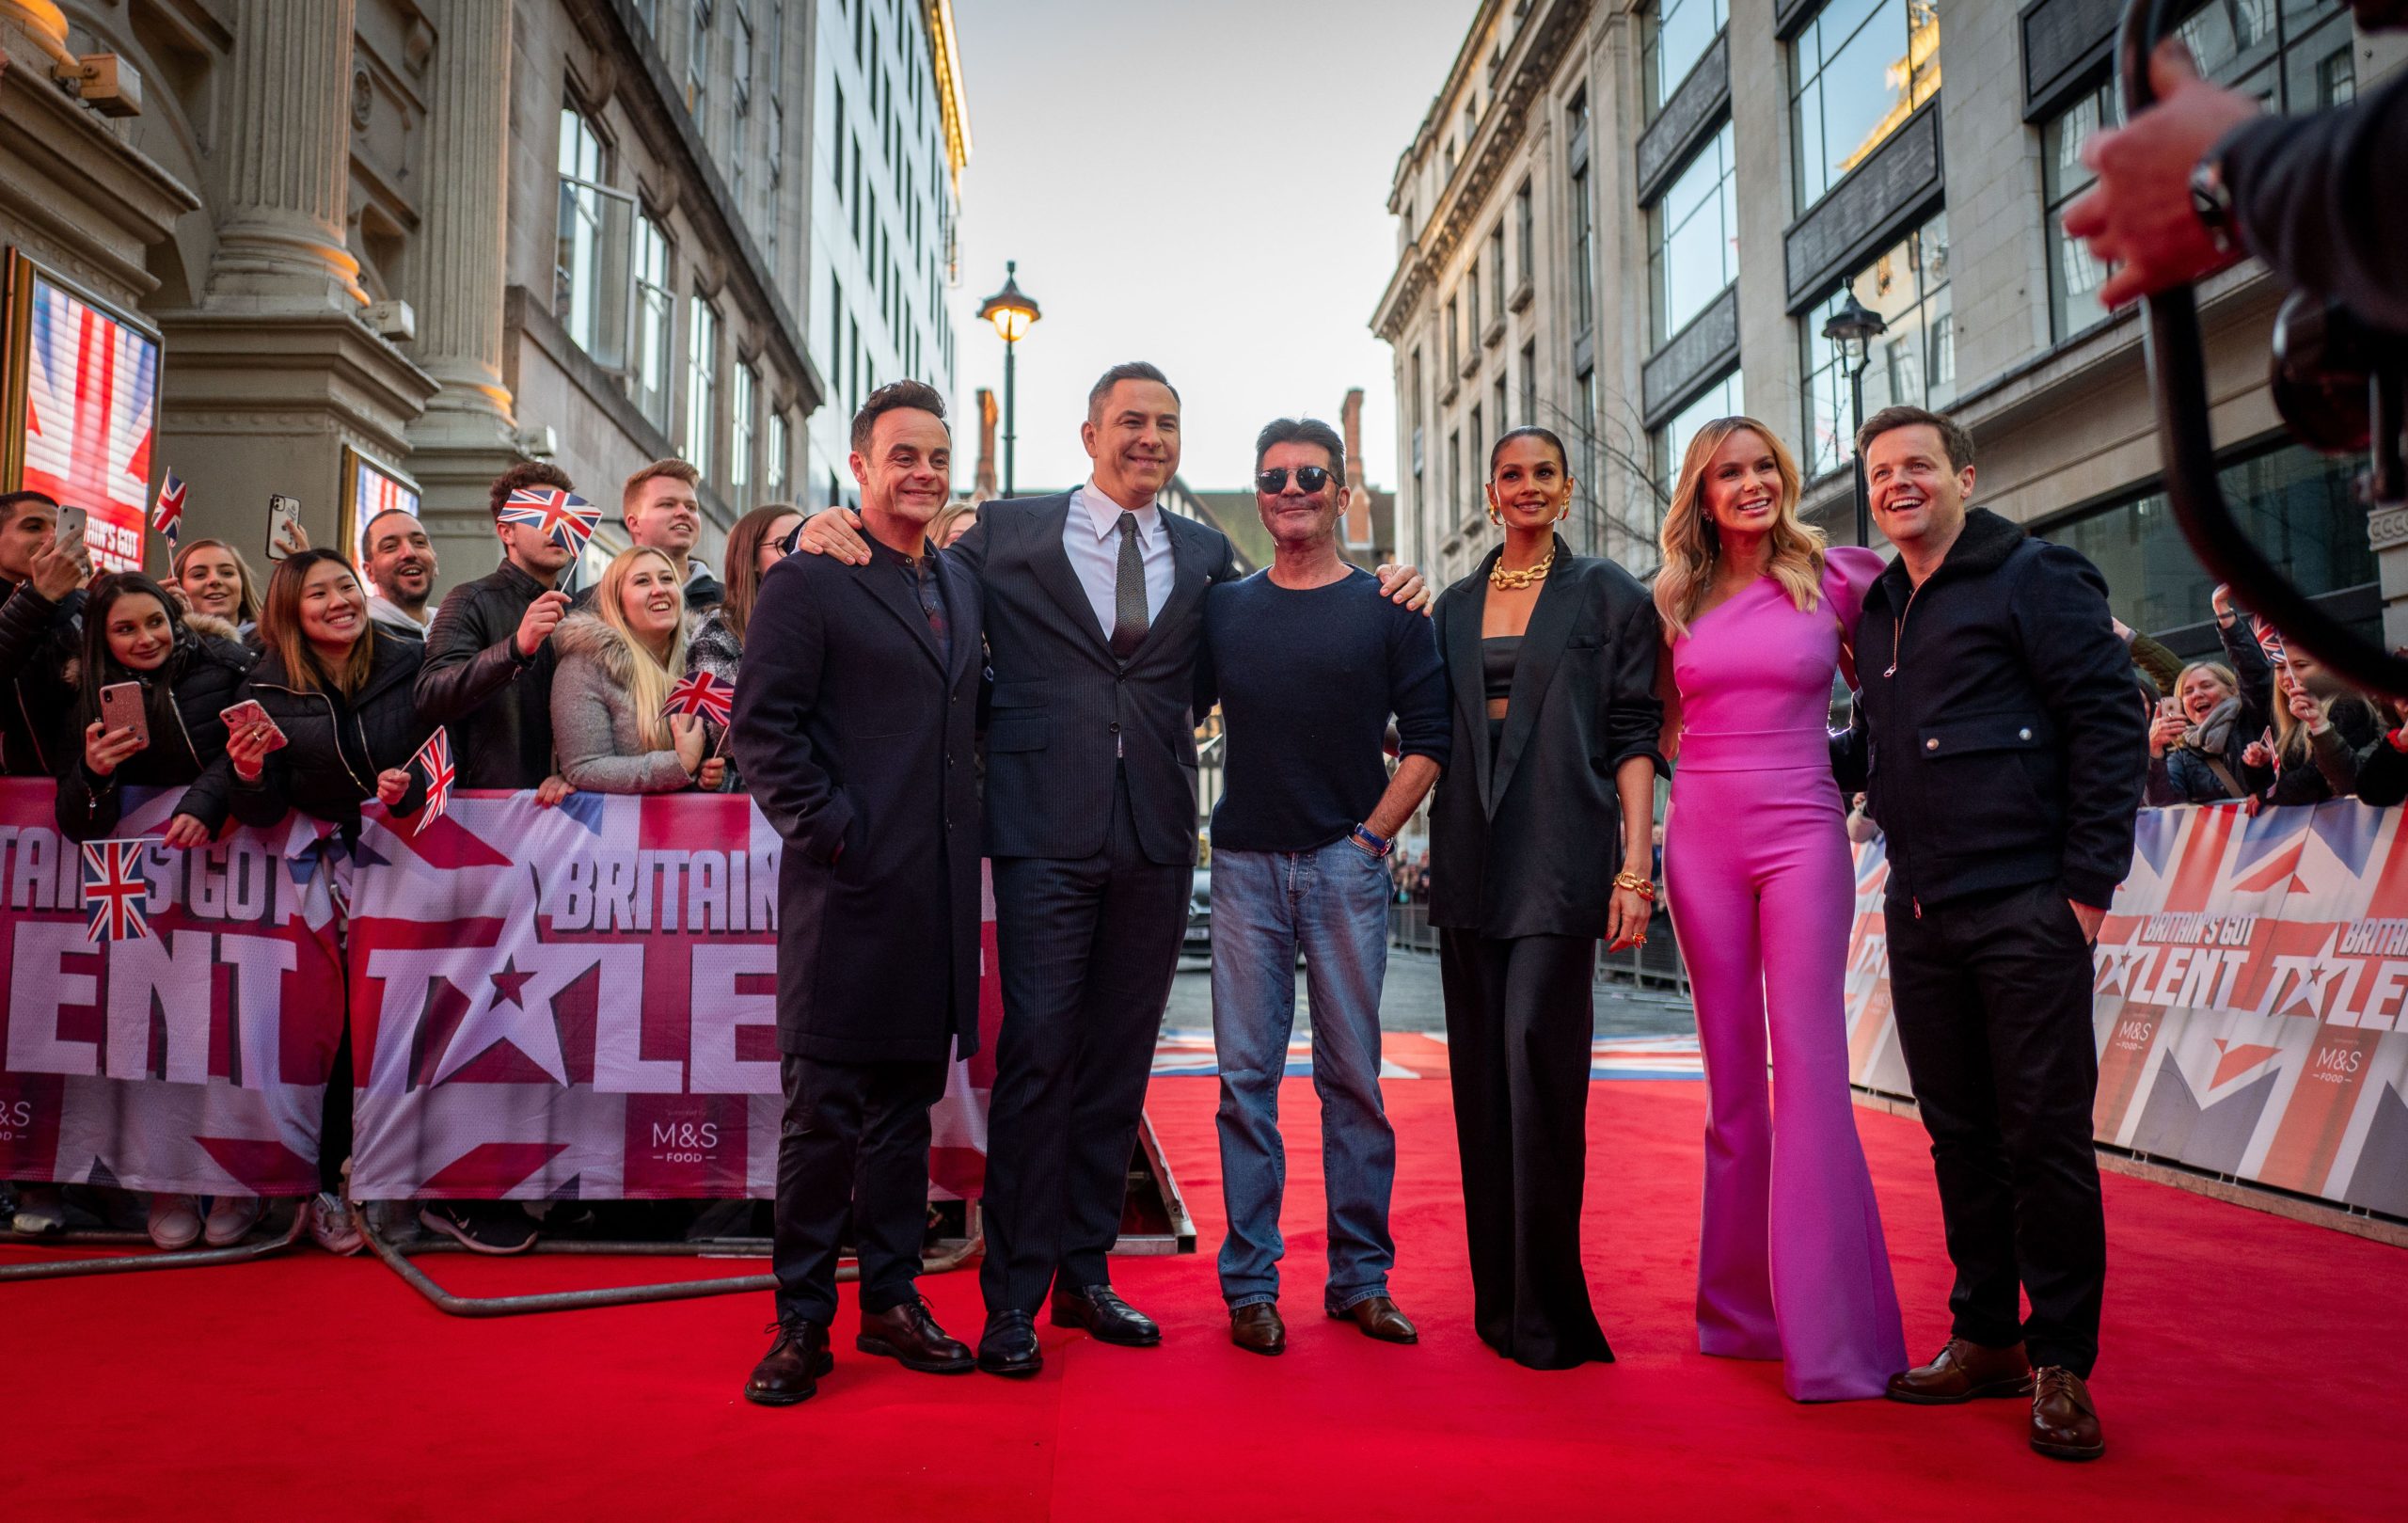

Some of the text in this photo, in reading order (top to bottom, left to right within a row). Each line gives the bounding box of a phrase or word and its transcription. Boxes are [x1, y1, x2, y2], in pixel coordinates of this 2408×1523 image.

[2143, 911, 2259, 946] BRITAIN'S GOT
[2118, 1021, 2152, 1041] M&S
[2316, 1047, 2362, 1072] M&S
[2320, 1072, 2344, 1084] FOOD
[653, 1122, 718, 1148] M&S
[666, 1152, 703, 1163] FOOD
